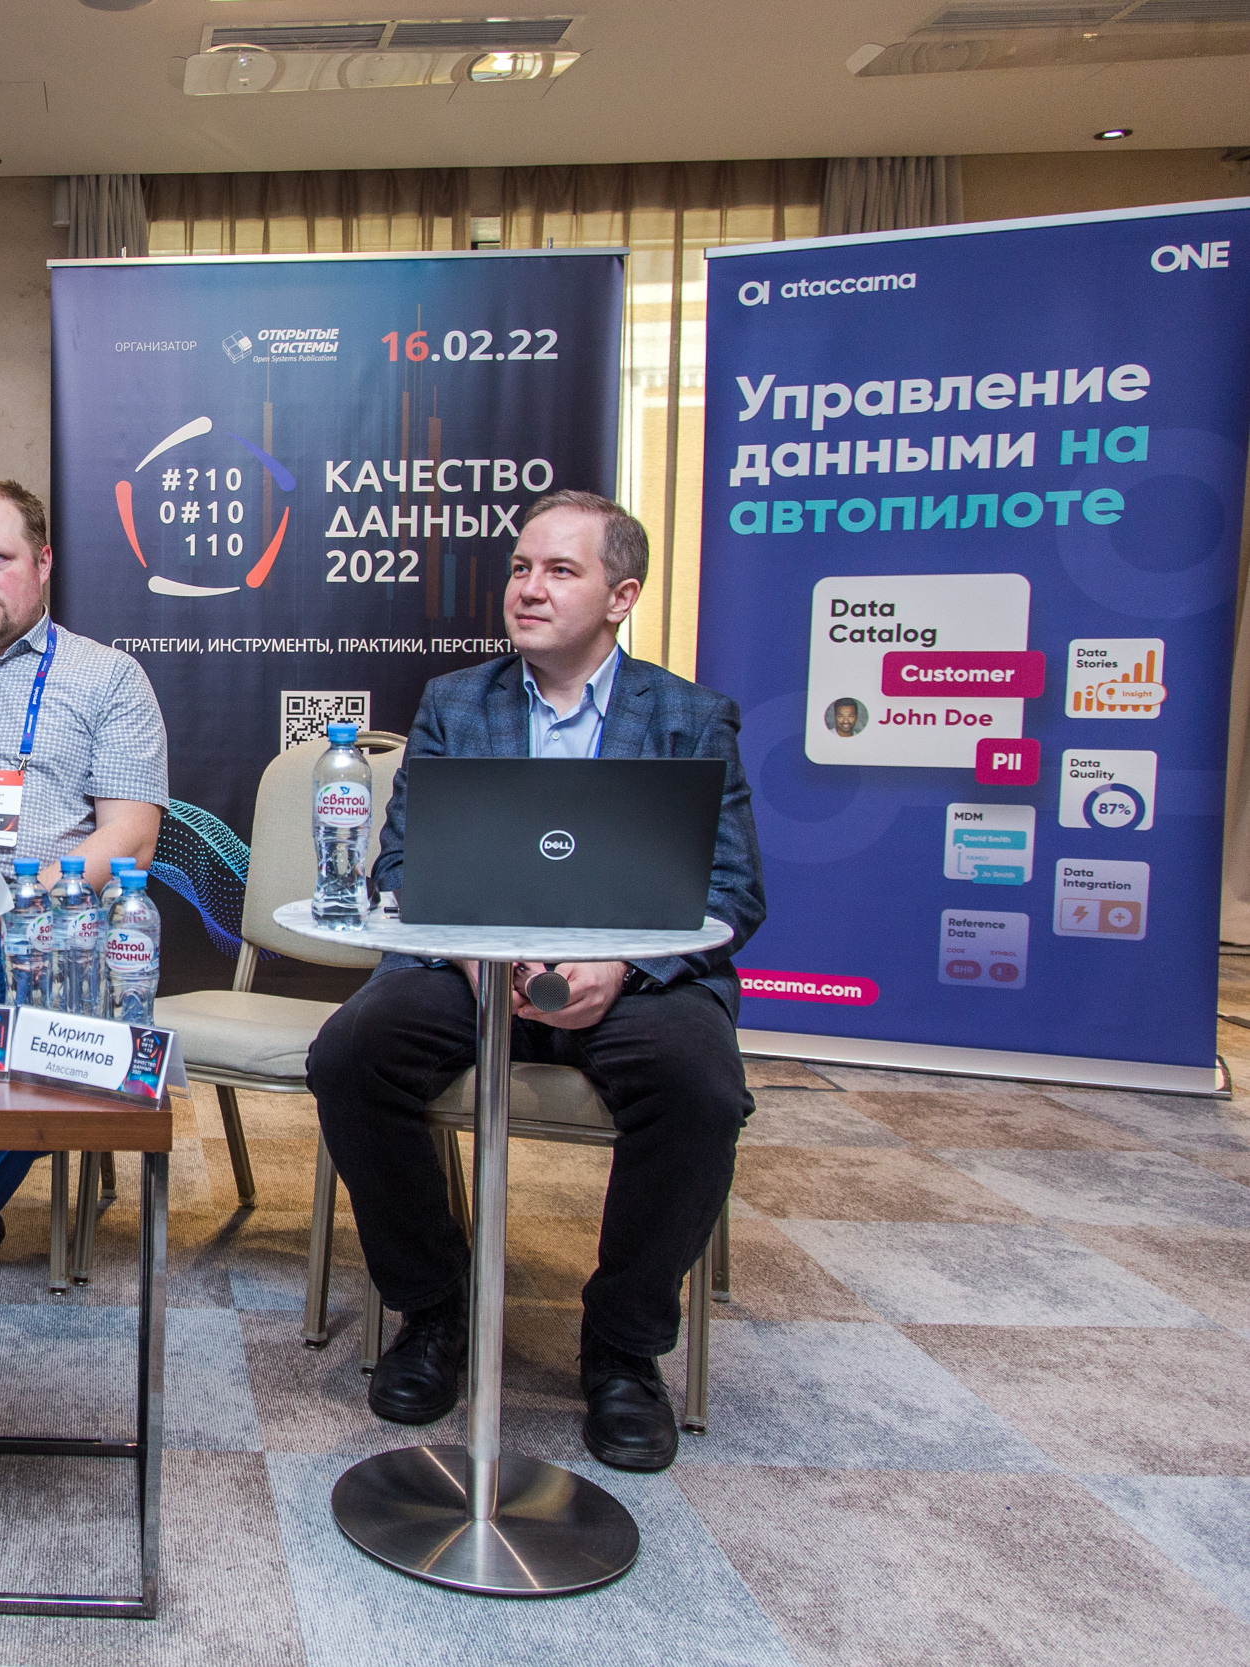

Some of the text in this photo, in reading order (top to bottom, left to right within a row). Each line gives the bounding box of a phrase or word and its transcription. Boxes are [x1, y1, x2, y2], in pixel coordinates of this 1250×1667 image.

[1151, 240, 1231, 273] ONE
[780, 272, 917, 300] ataccama
[257, 328, 340, 341] ОТКРЫТЫЕ
[114, 340, 197, 352] ОРГАНИЗАТОР
[270, 341, 339, 354] СИСТЕМЫ
[380, 328, 559, 363] 16.02.22
[253, 354, 338, 364] Open Systems Publications
[735, 363, 1152, 431] Управление
[729, 424, 1150, 488] данными на
[325, 457, 555, 494] КАЧЕСТВО
[729, 487, 1126, 536] автопилоте
[325, 505, 521, 539] ДАННЫХ
[185, 533, 244, 558] 110
[325, 550, 420, 584] 2022
[830, 598, 896, 618] Data
[828, 623, 939, 648] Catalog
[111, 637, 517, 655] СТРАТЕГИИ, ИНСТРУМЕНТЫ, ПРАКТИКИ, ПЕРСПЕКТ
[1076, 648, 1108, 658] Data
[1075, 659, 1119, 669] Stories
[900, 664, 1015, 684] Customer
[1121, 690, 1153, 699] Insight
[878, 708, 994, 727] John Doe
[992, 752, 1022, 771] PII
[1070, 758, 1101, 768] Data
[1069, 769, 1116, 781] Quality
[954, 812, 984, 821] MDM
[1097, 802, 1132, 816] 87%
[544, 840, 571, 850] DELL
[1063, 867, 1094, 878] Data
[1062, 878, 1132, 891] Integration
[947, 928, 977, 938] Data
[948, 917, 1006, 930] Reference
[740, 978, 863, 998] accama.com
[48, 1021, 105, 1046] Кирилл
[30, 1036, 114, 1067] Евдокимов
[45, 1061, 89, 1080] Ataccama
